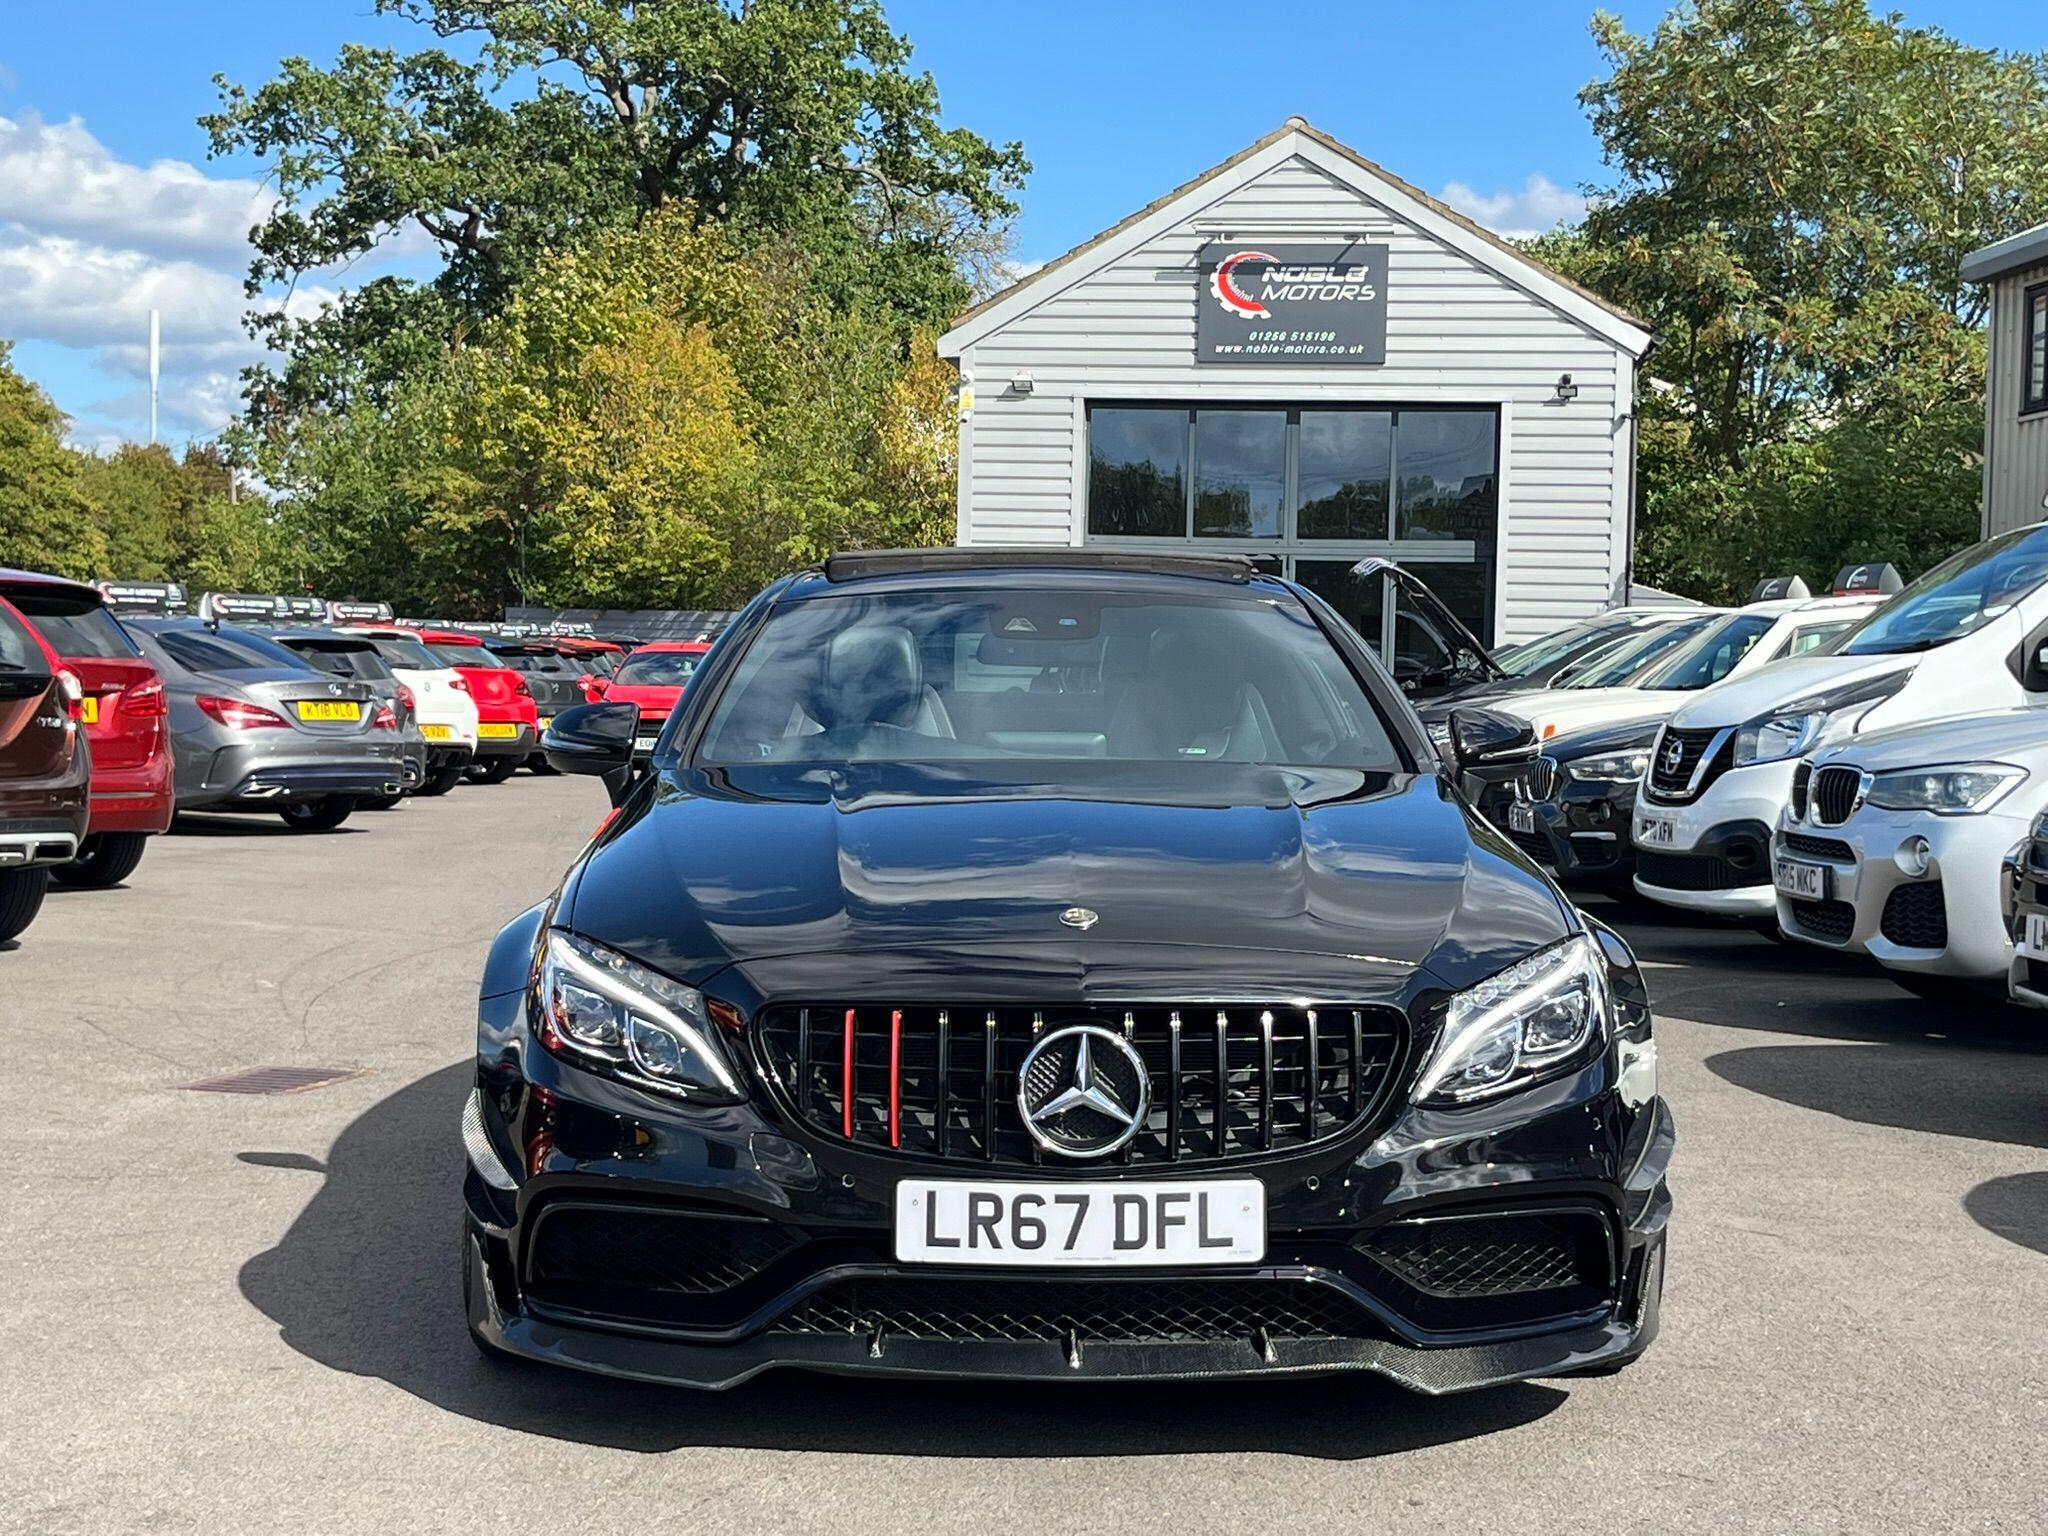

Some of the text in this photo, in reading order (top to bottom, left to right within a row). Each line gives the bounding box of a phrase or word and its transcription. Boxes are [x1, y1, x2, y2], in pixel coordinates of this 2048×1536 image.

[1261, 265, 1369, 283] NOBLE
[1260, 284, 1377, 301] MOTORS
[1248, 331, 1286, 342] 01256
[1214, 343, 1365, 355] www.noble-motors.co.uk
[925, 1190, 1234, 1251] LR67 DFL
